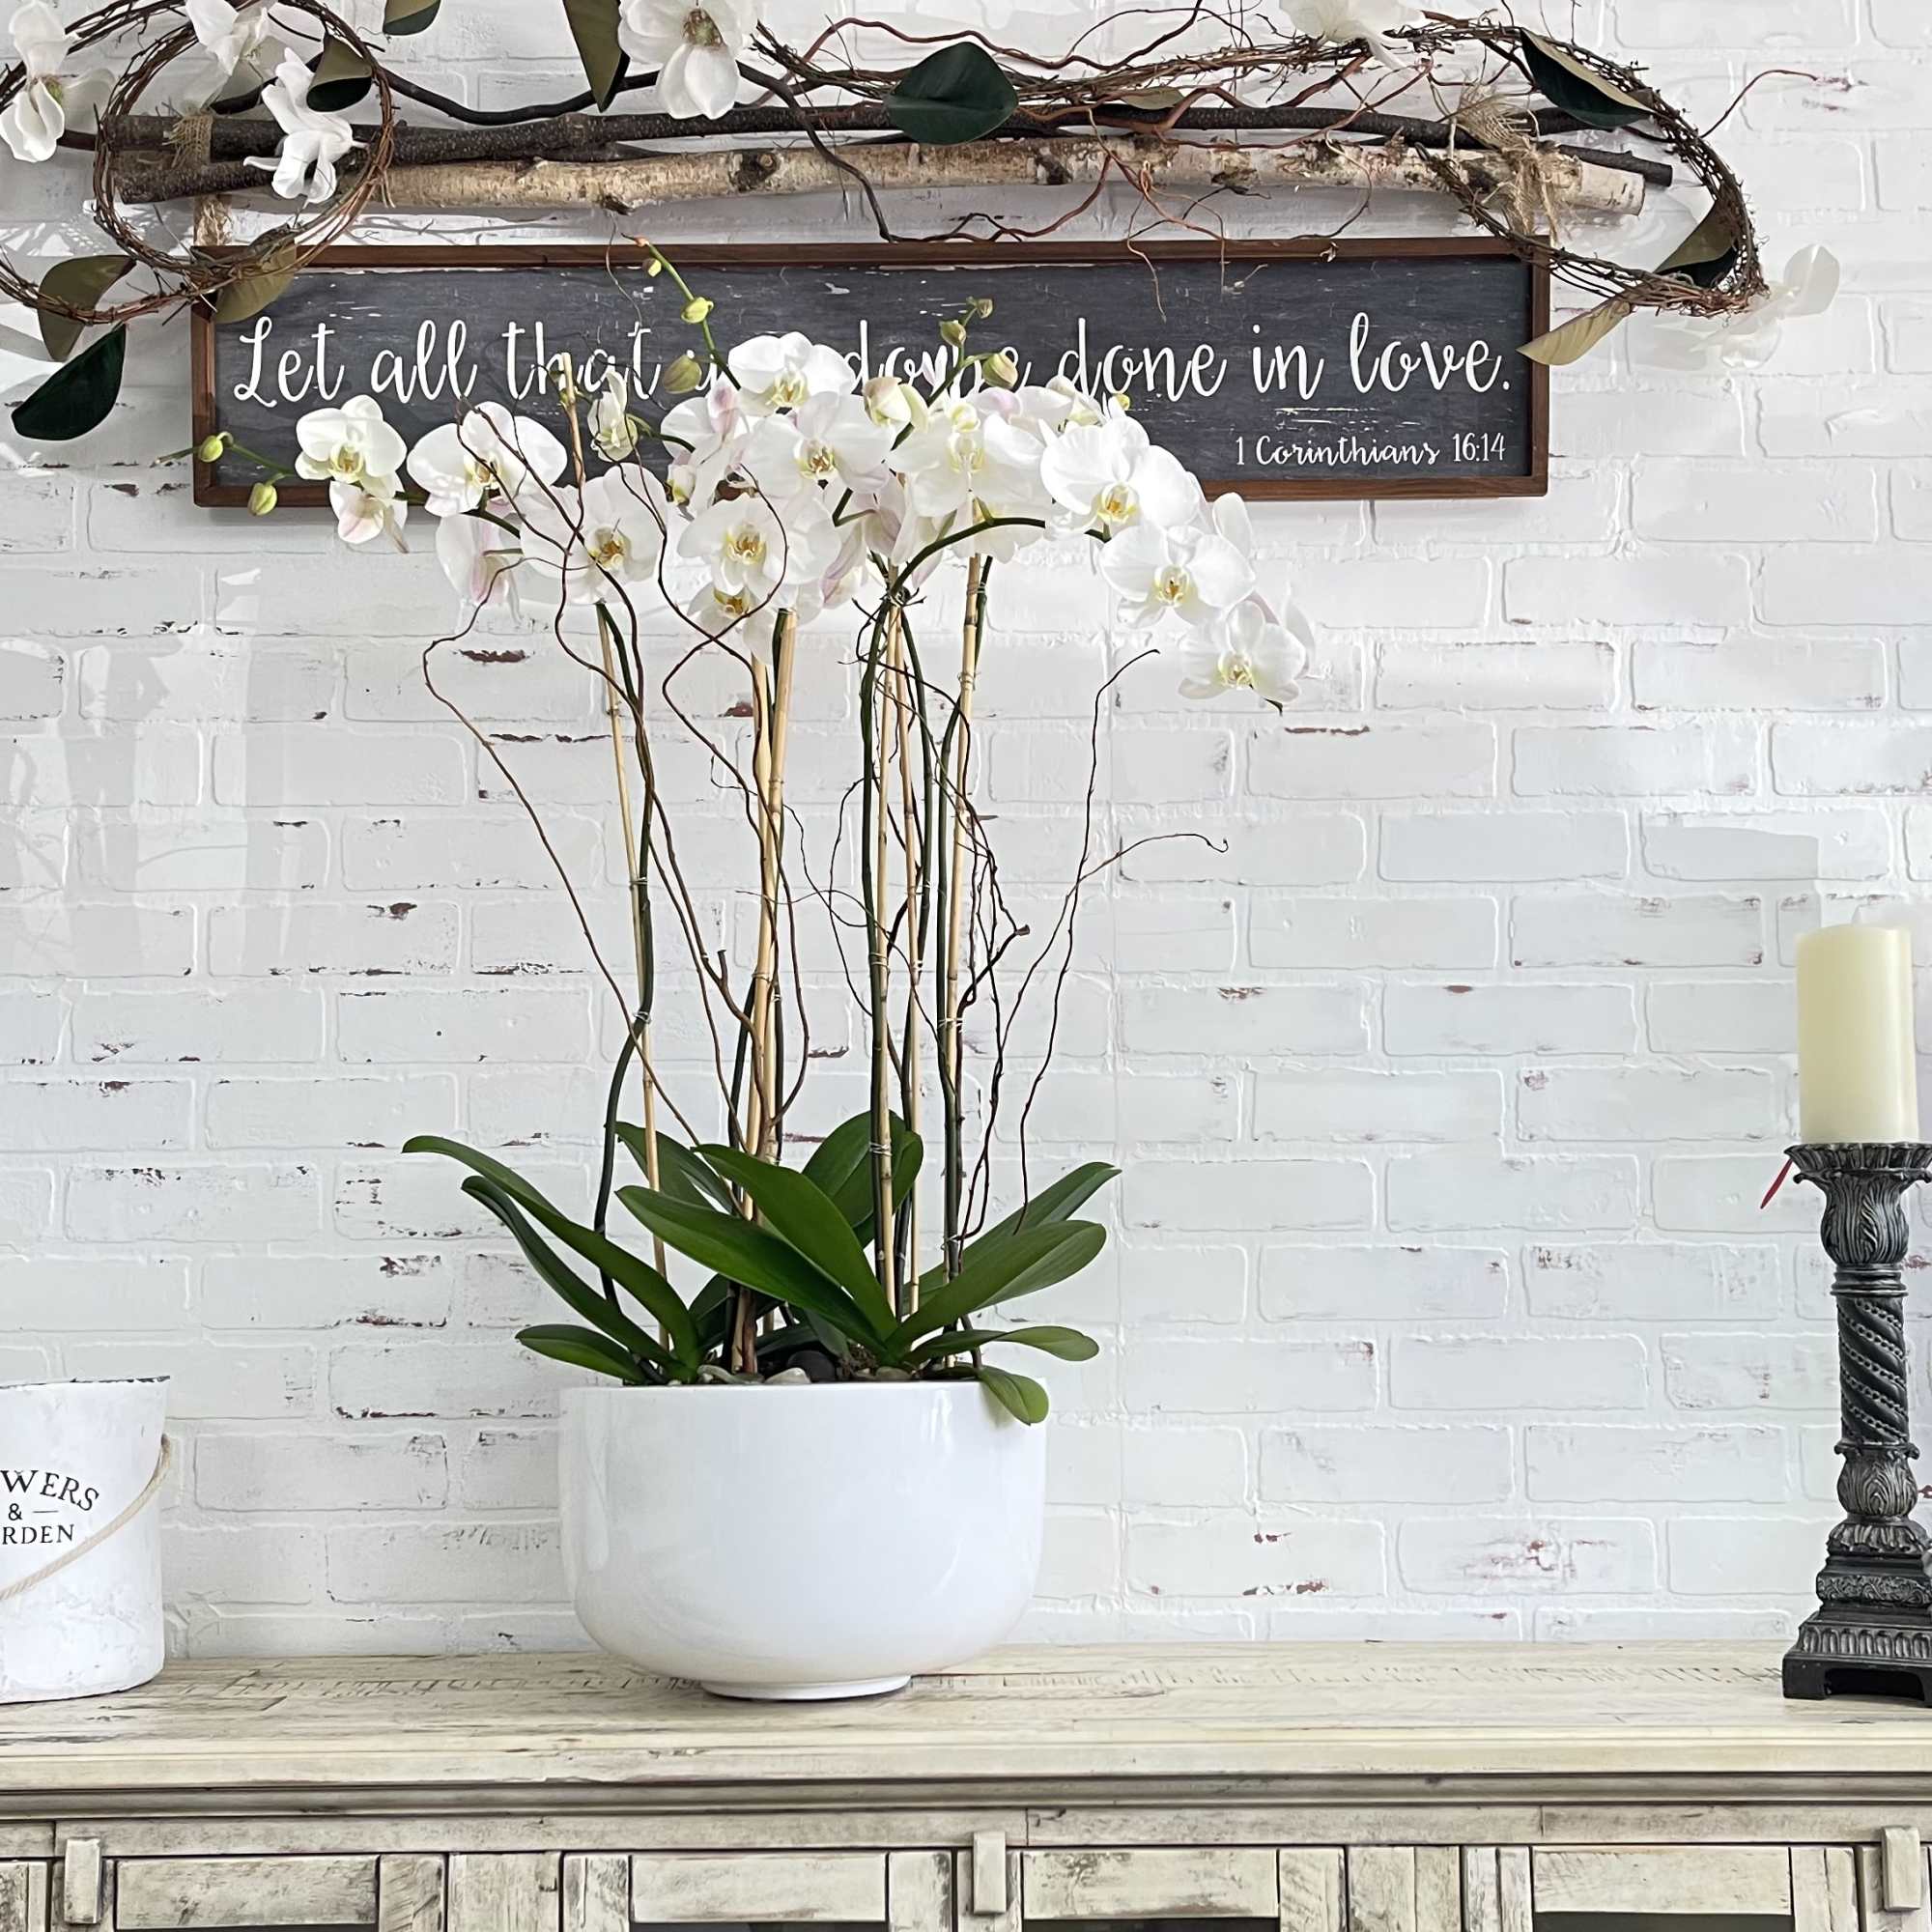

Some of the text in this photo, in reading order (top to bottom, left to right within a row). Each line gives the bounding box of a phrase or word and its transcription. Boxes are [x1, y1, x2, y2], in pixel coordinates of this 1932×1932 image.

[233, 316, 345, 408] Let
[370, 319, 478, 404] all
[501, 321, 662, 400] that
[1056, 317, 1228, 403] done
[1252, 324, 1324, 401] in
[1350, 311, 1511, 394] love.
[1235, 432, 1507, 467] 1 Corinthians 16:14
[8, 1502, 23, 1521] &
